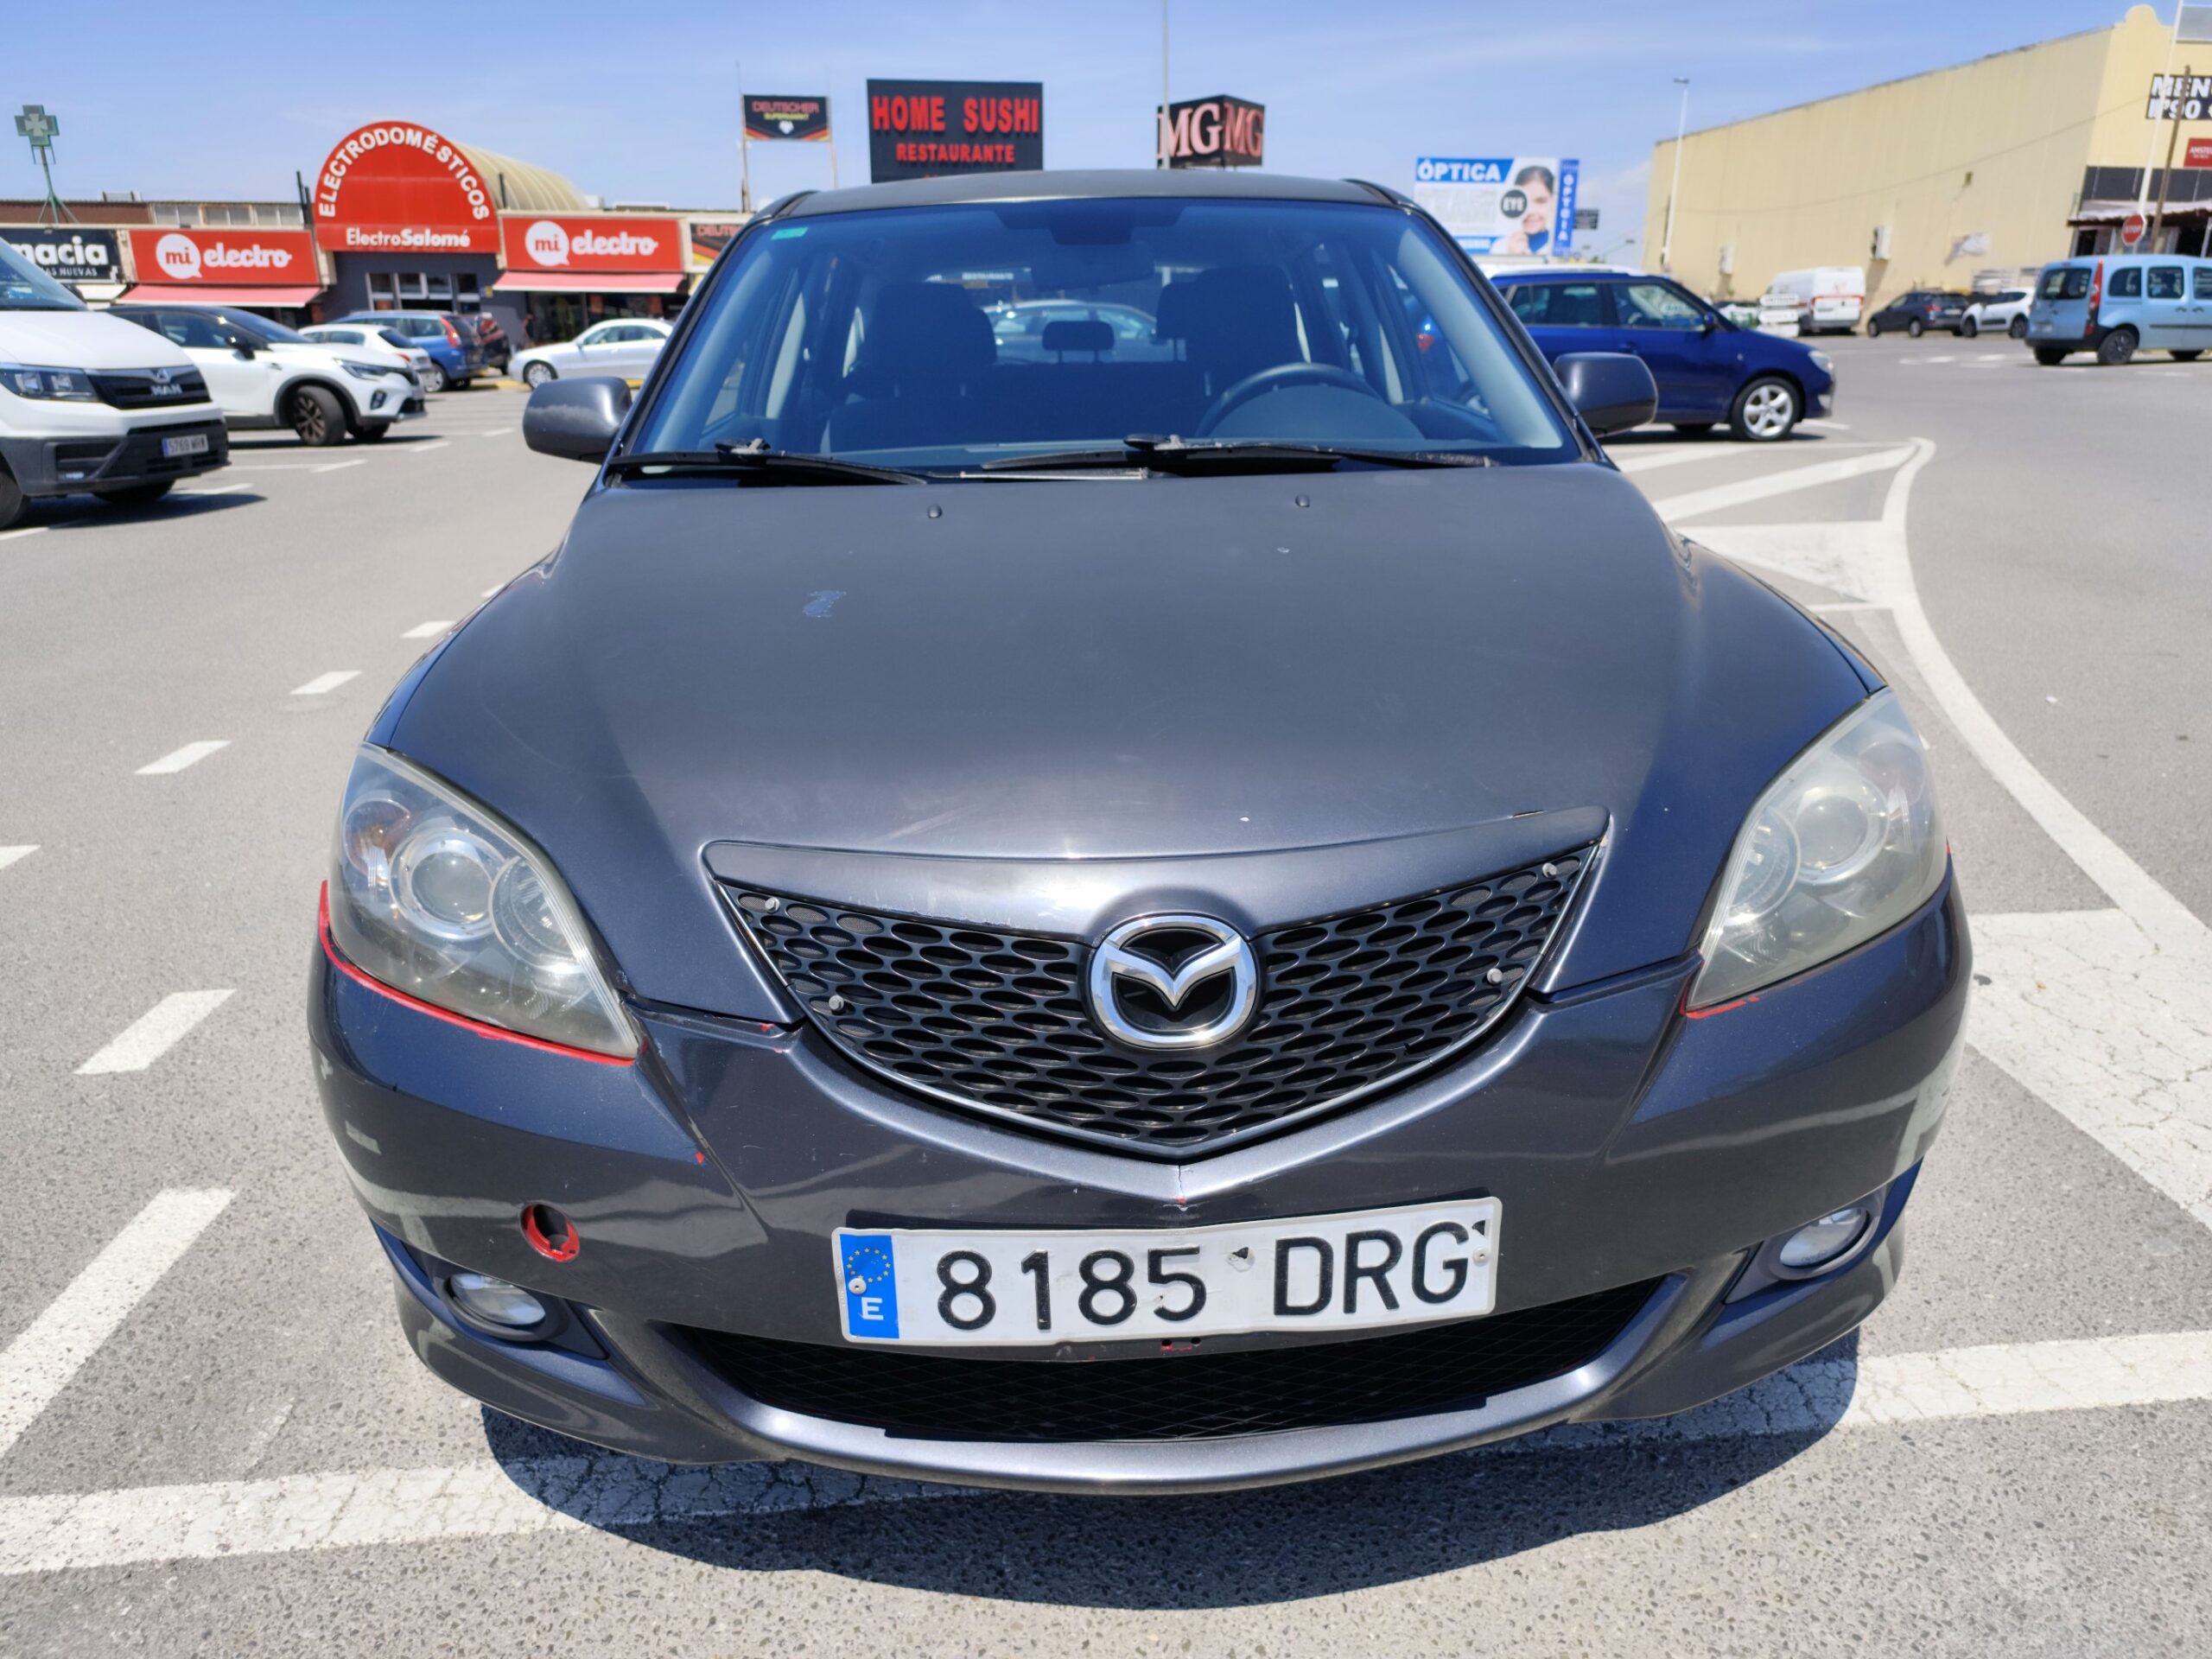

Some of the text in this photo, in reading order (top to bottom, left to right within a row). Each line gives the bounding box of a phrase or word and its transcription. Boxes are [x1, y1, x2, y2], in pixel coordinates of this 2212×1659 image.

[2152, 76, 2212, 98] MEN
[873, 96, 1039, 133] HOME SUSHI
[1157, 103, 1224, 158] MG
[1224, 102, 1263, 157] MG
[896, 143, 1015, 162] RESTAURANTE
[319, 126, 490, 220] ELECTRODOMÉSTICOS
[1418, 159, 1502, 181] ÓPTICA
[346, 227, 470, 247] ElectroSalomé
[535, 230, 658, 256] mi electro
[166, 242, 292, 268] mi electro
[935, 1221, 1469, 1331] 8185 DRG
[861, 1296, 885, 1320] E
